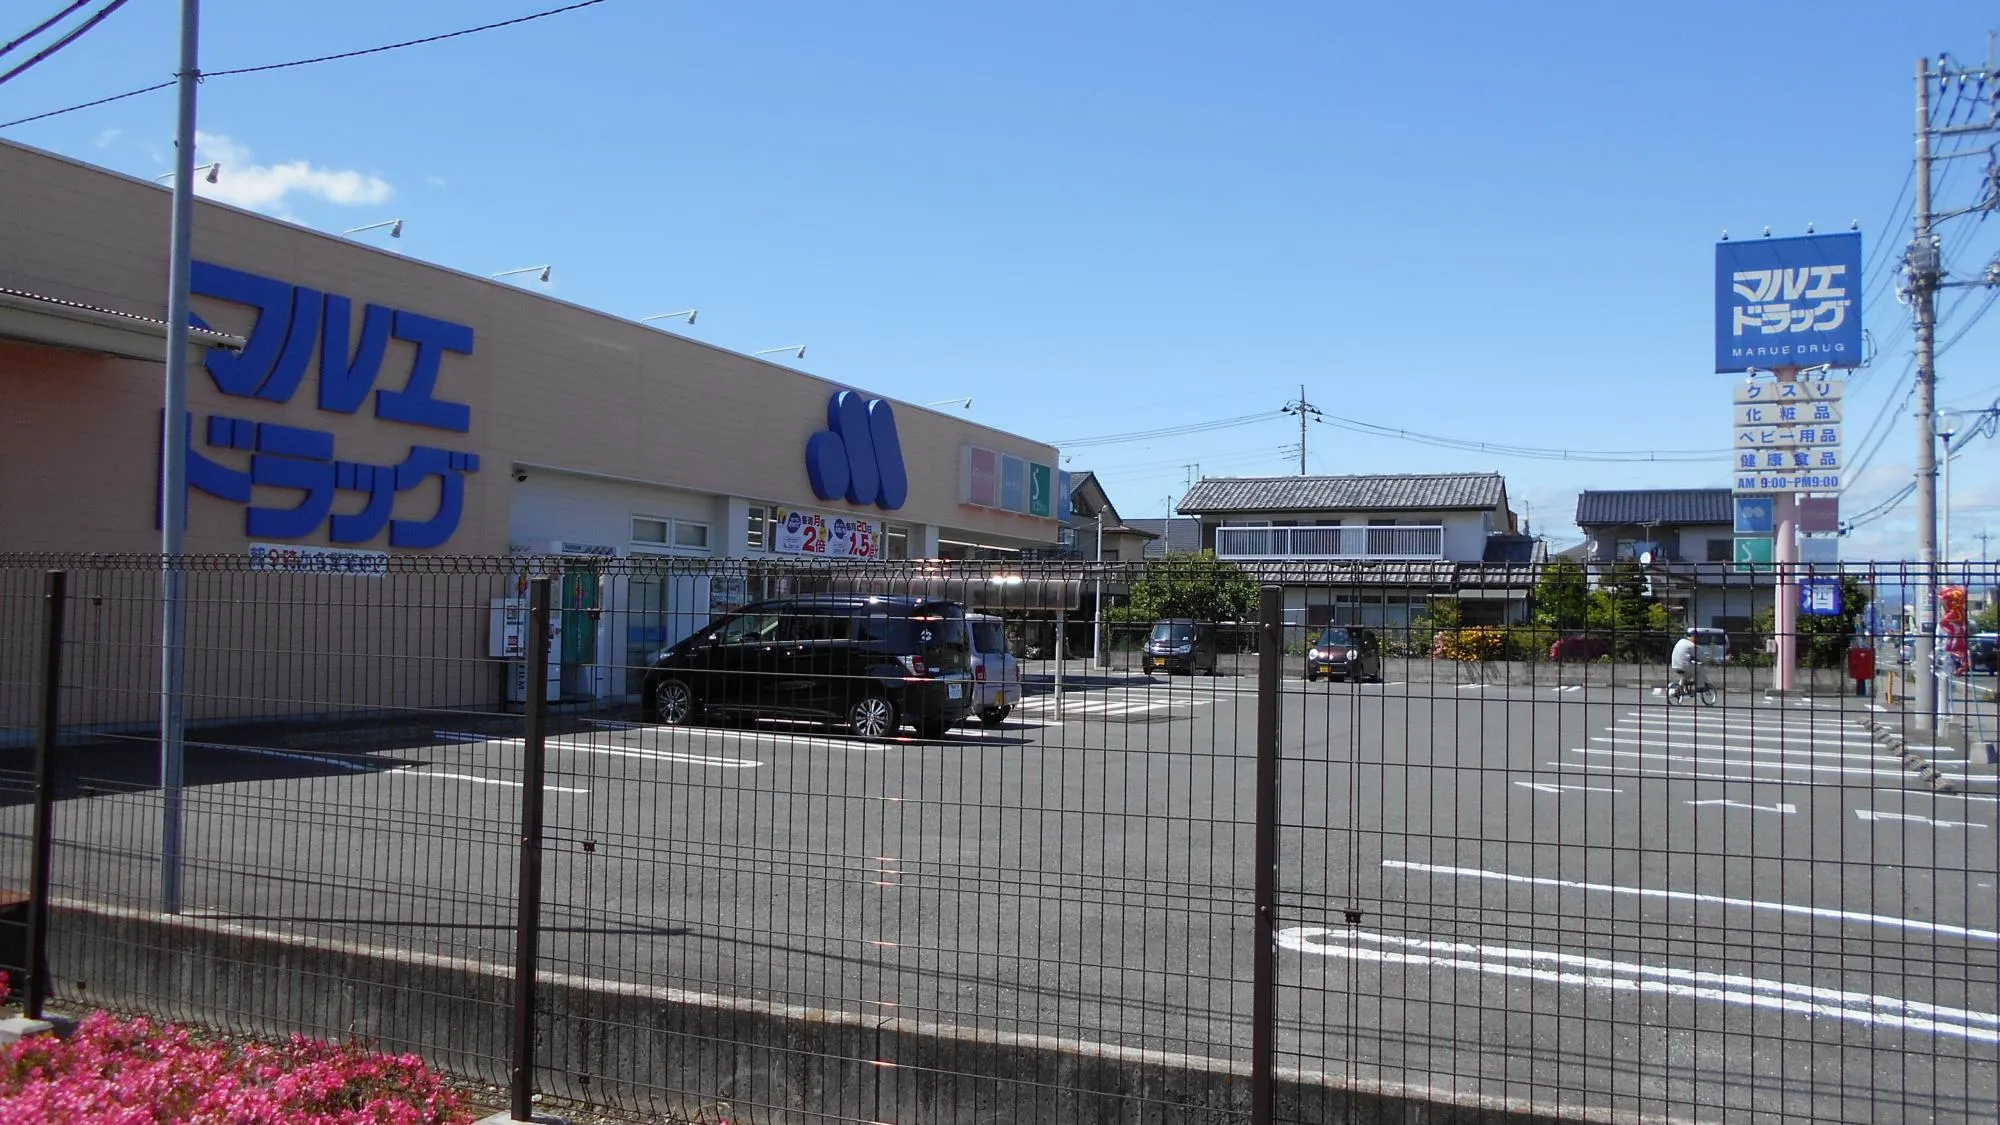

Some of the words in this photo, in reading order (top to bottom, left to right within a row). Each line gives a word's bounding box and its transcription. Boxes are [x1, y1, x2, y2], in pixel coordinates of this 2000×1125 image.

[1733, 265, 1846, 302] マルエ
[1733, 299, 1852, 336] ドラッグ
[190, 259, 474, 433] マルエ
[1732, 345, 1791, 357] MARUE
[1797, 343, 1845, 353] DRUG
[1747, 384, 1831, 399] クスリ
[1746, 405, 1831, 422] 化粧品
[1739, 429, 1836, 444] ベビー用品
[1740, 451, 1836, 468] 健康食品
[156, 408, 480, 548] ドラッグ
[1738, 478, 1755, 489] AM
[1802, 584, 1834, 610] 酒
